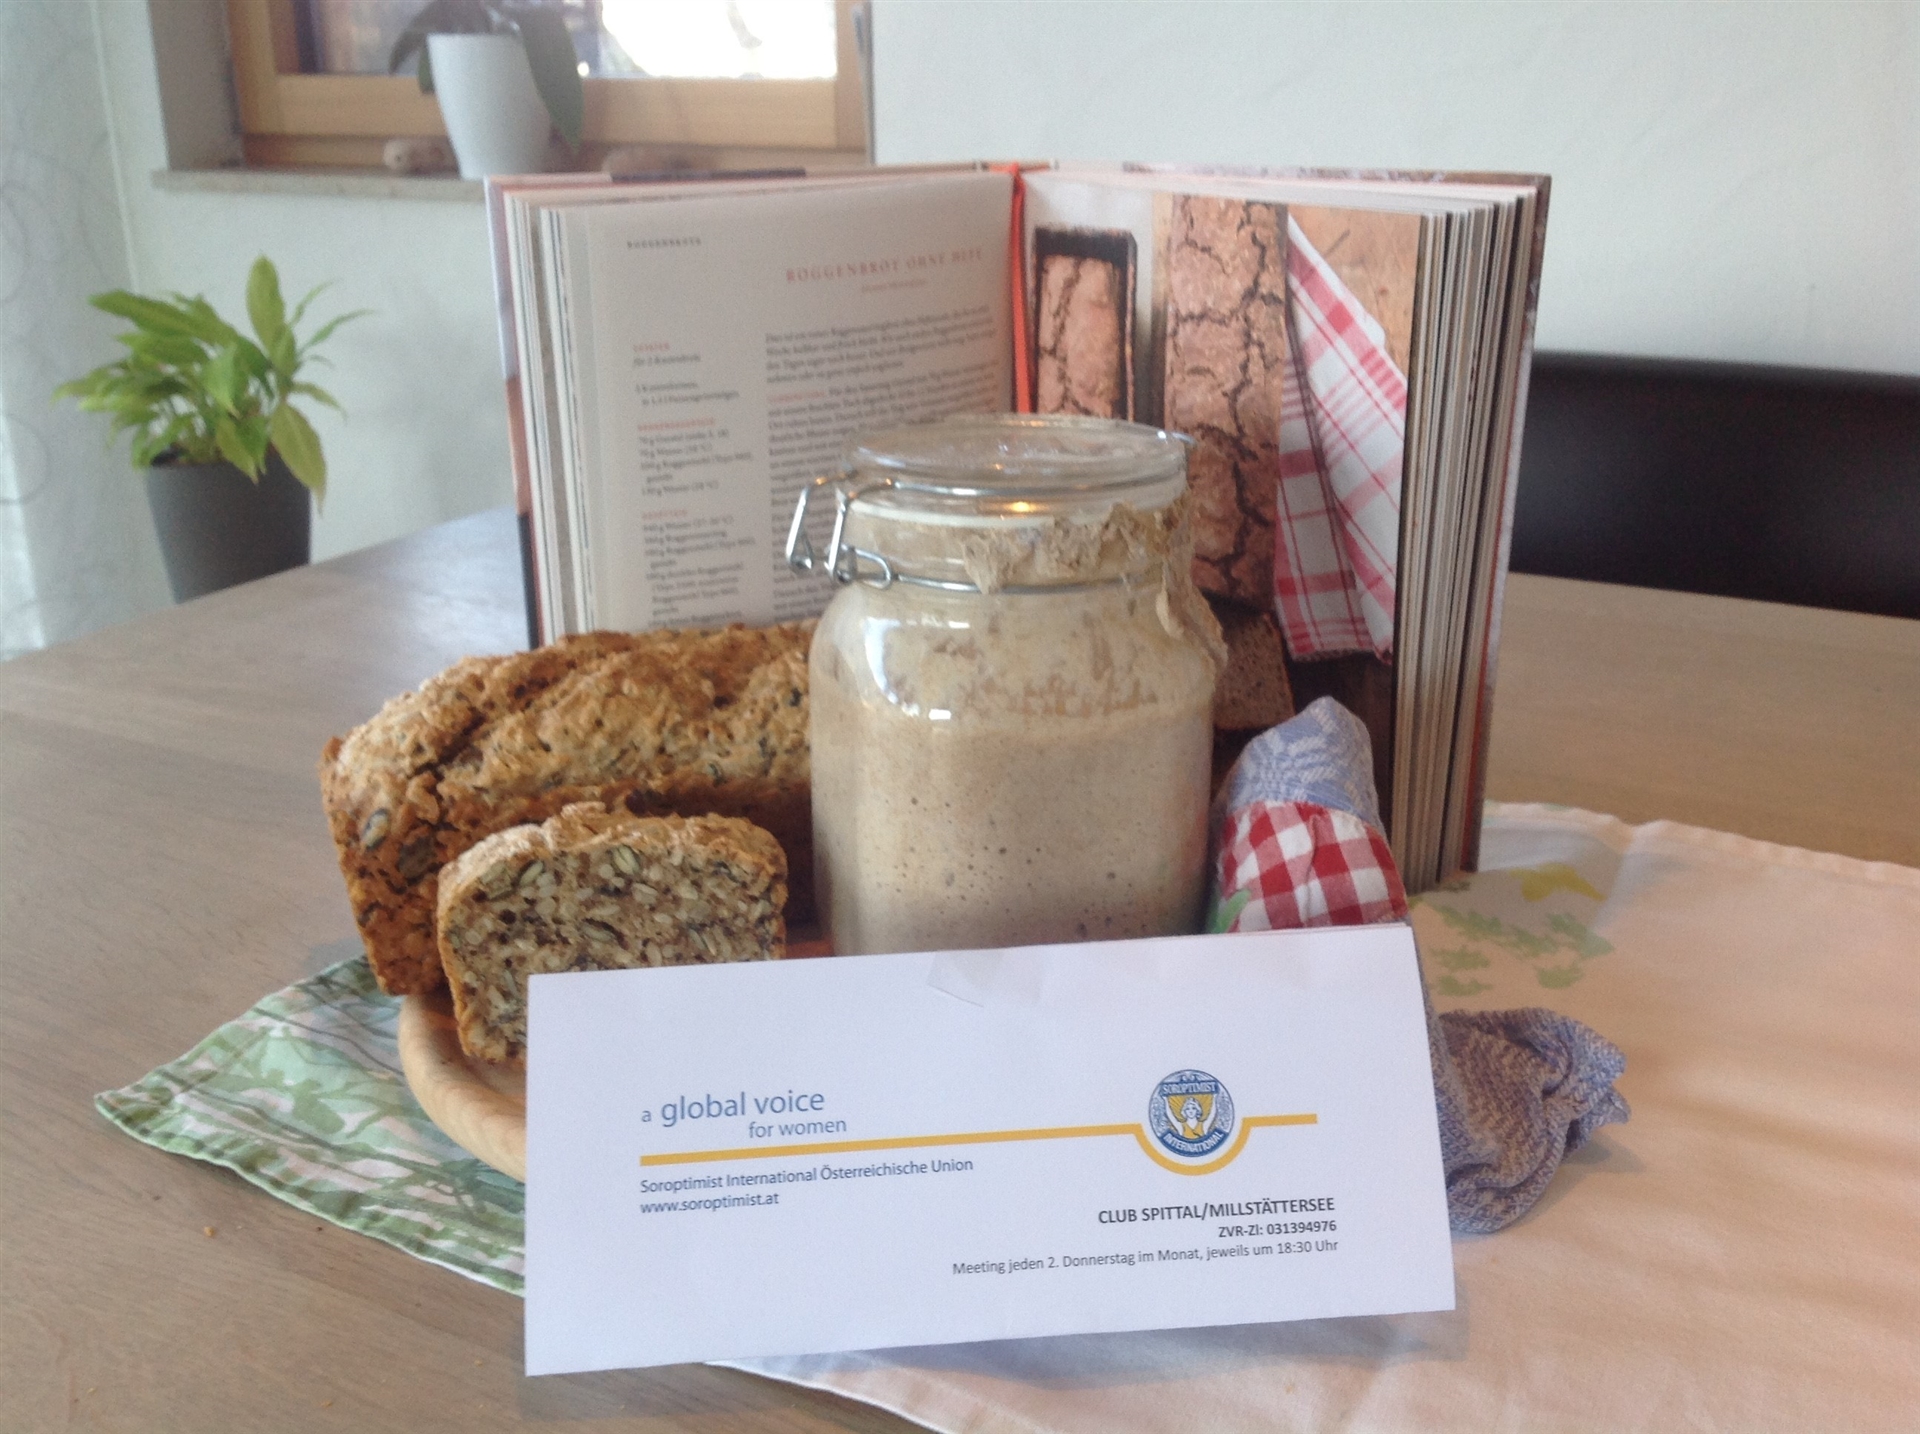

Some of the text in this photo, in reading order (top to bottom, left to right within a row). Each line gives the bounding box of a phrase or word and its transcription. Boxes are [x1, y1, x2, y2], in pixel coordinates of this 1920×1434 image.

[1162, 1082, 1217, 1095] SOROPTIMIST
[641, 1090, 825, 1127] a global voice
[749, 1119, 847, 1138] for women
[1163, 1131, 1224, 1153] INTERNATIONAL
[640, 1158, 974, 1194] Soroptimist International Österreichische Union
[640, 1192, 779, 1214] www.soroptimist.at
[1098, 1197, 1335, 1224] CLUB SPITTAL/MILLSTÄTTERSEE
[1266, 1220, 1337, 1236] 031394976
[952, 1239, 1339, 1275] Meeting jeden 2. Donnerstag im Monat, jeweils um 18:30 Uhr
